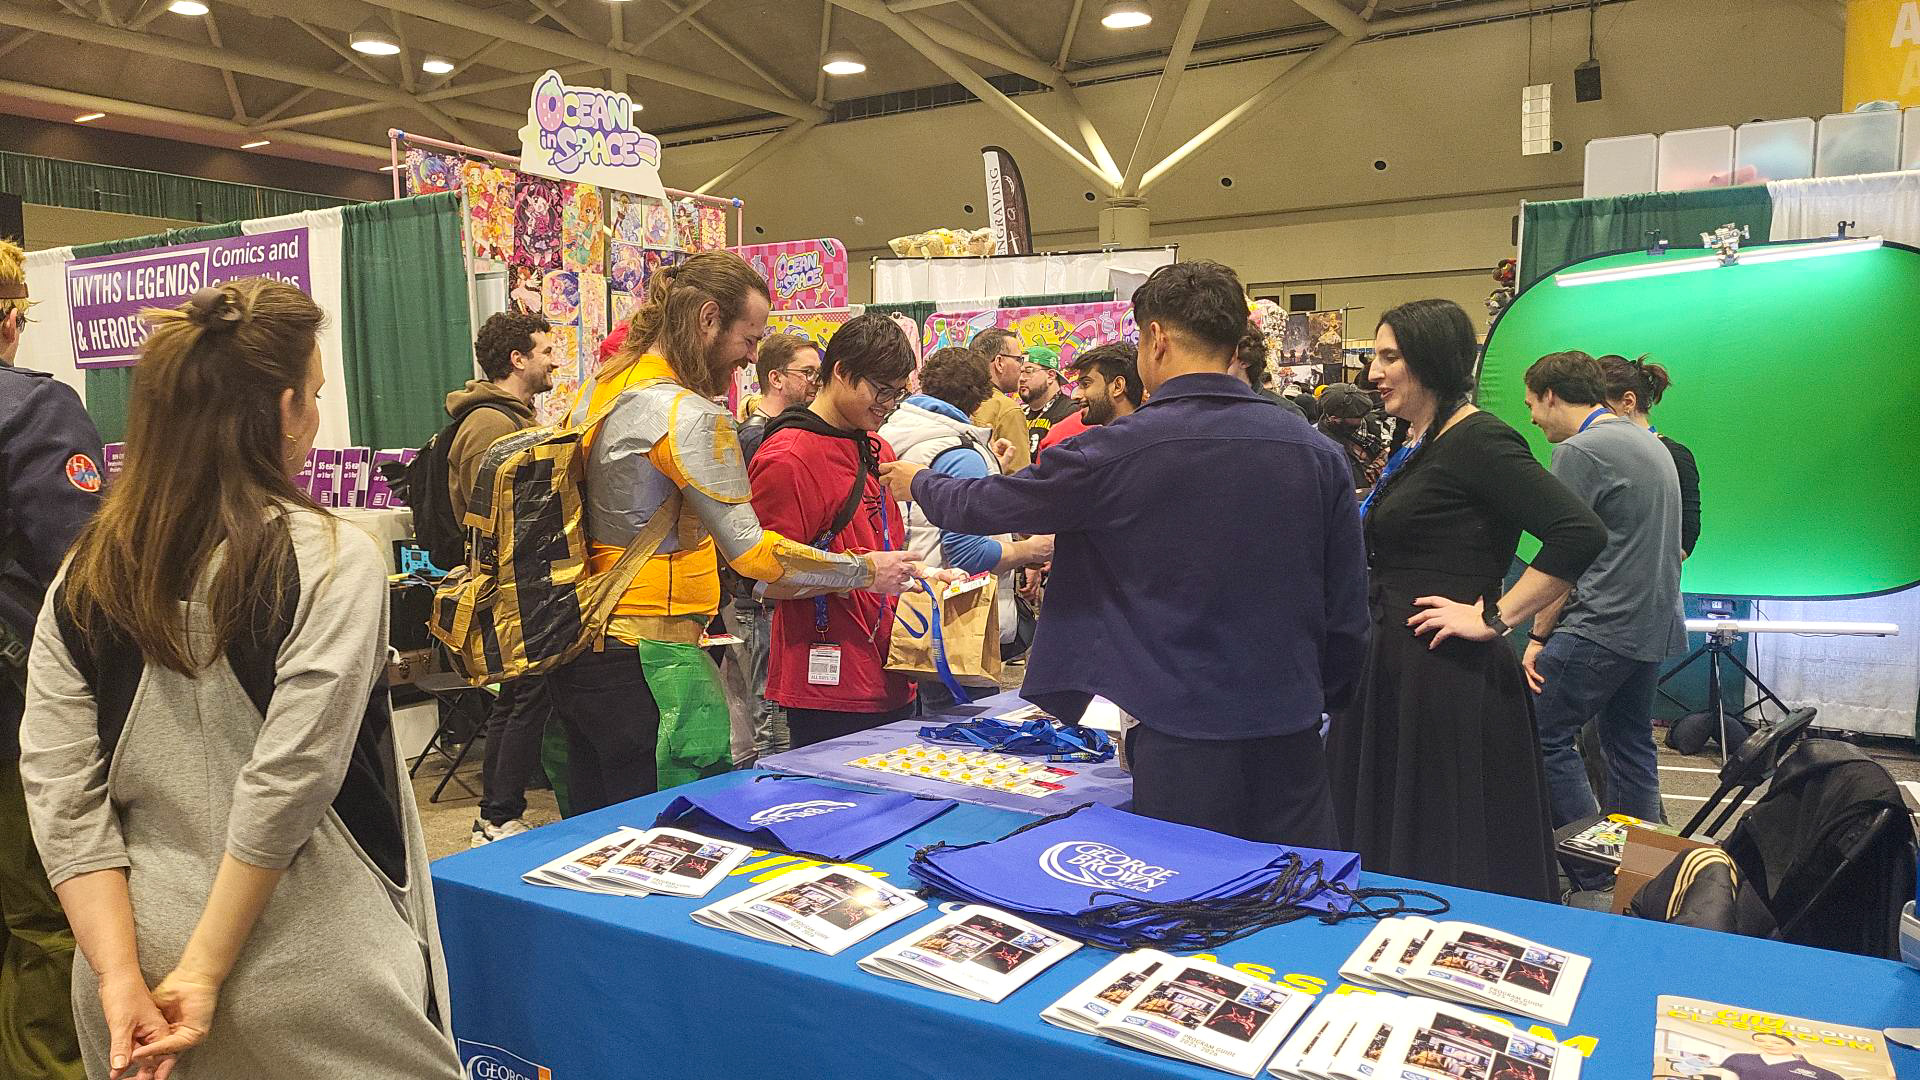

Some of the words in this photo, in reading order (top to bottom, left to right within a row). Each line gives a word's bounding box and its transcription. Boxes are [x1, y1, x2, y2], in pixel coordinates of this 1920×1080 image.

[536, 75, 629, 131] OCEAN
[540, 130, 557, 150] in
[549, 127, 640, 174] SPACE
[212, 243, 265, 268] Comics
[269, 235, 299, 260] and
[776, 252, 818, 279] OCEAN
[72, 271, 122, 307] MYTHS
[127, 261, 200, 302] LEGENDS
[781, 268, 822, 296] SPACE
[76, 320, 88, 351] &
[89, 317, 148, 350] HEROES
[1065, 854, 1168, 889] BROWN
[1075, 844, 1180, 881] GEORGE
[1184, 1033, 1215, 1049] PROGRAM
[1667, 1009, 1876, 1052] CLASSROOM
[1819, 1030, 1872, 1043] OUR
[476, 1060, 530, 1080] GEOR
